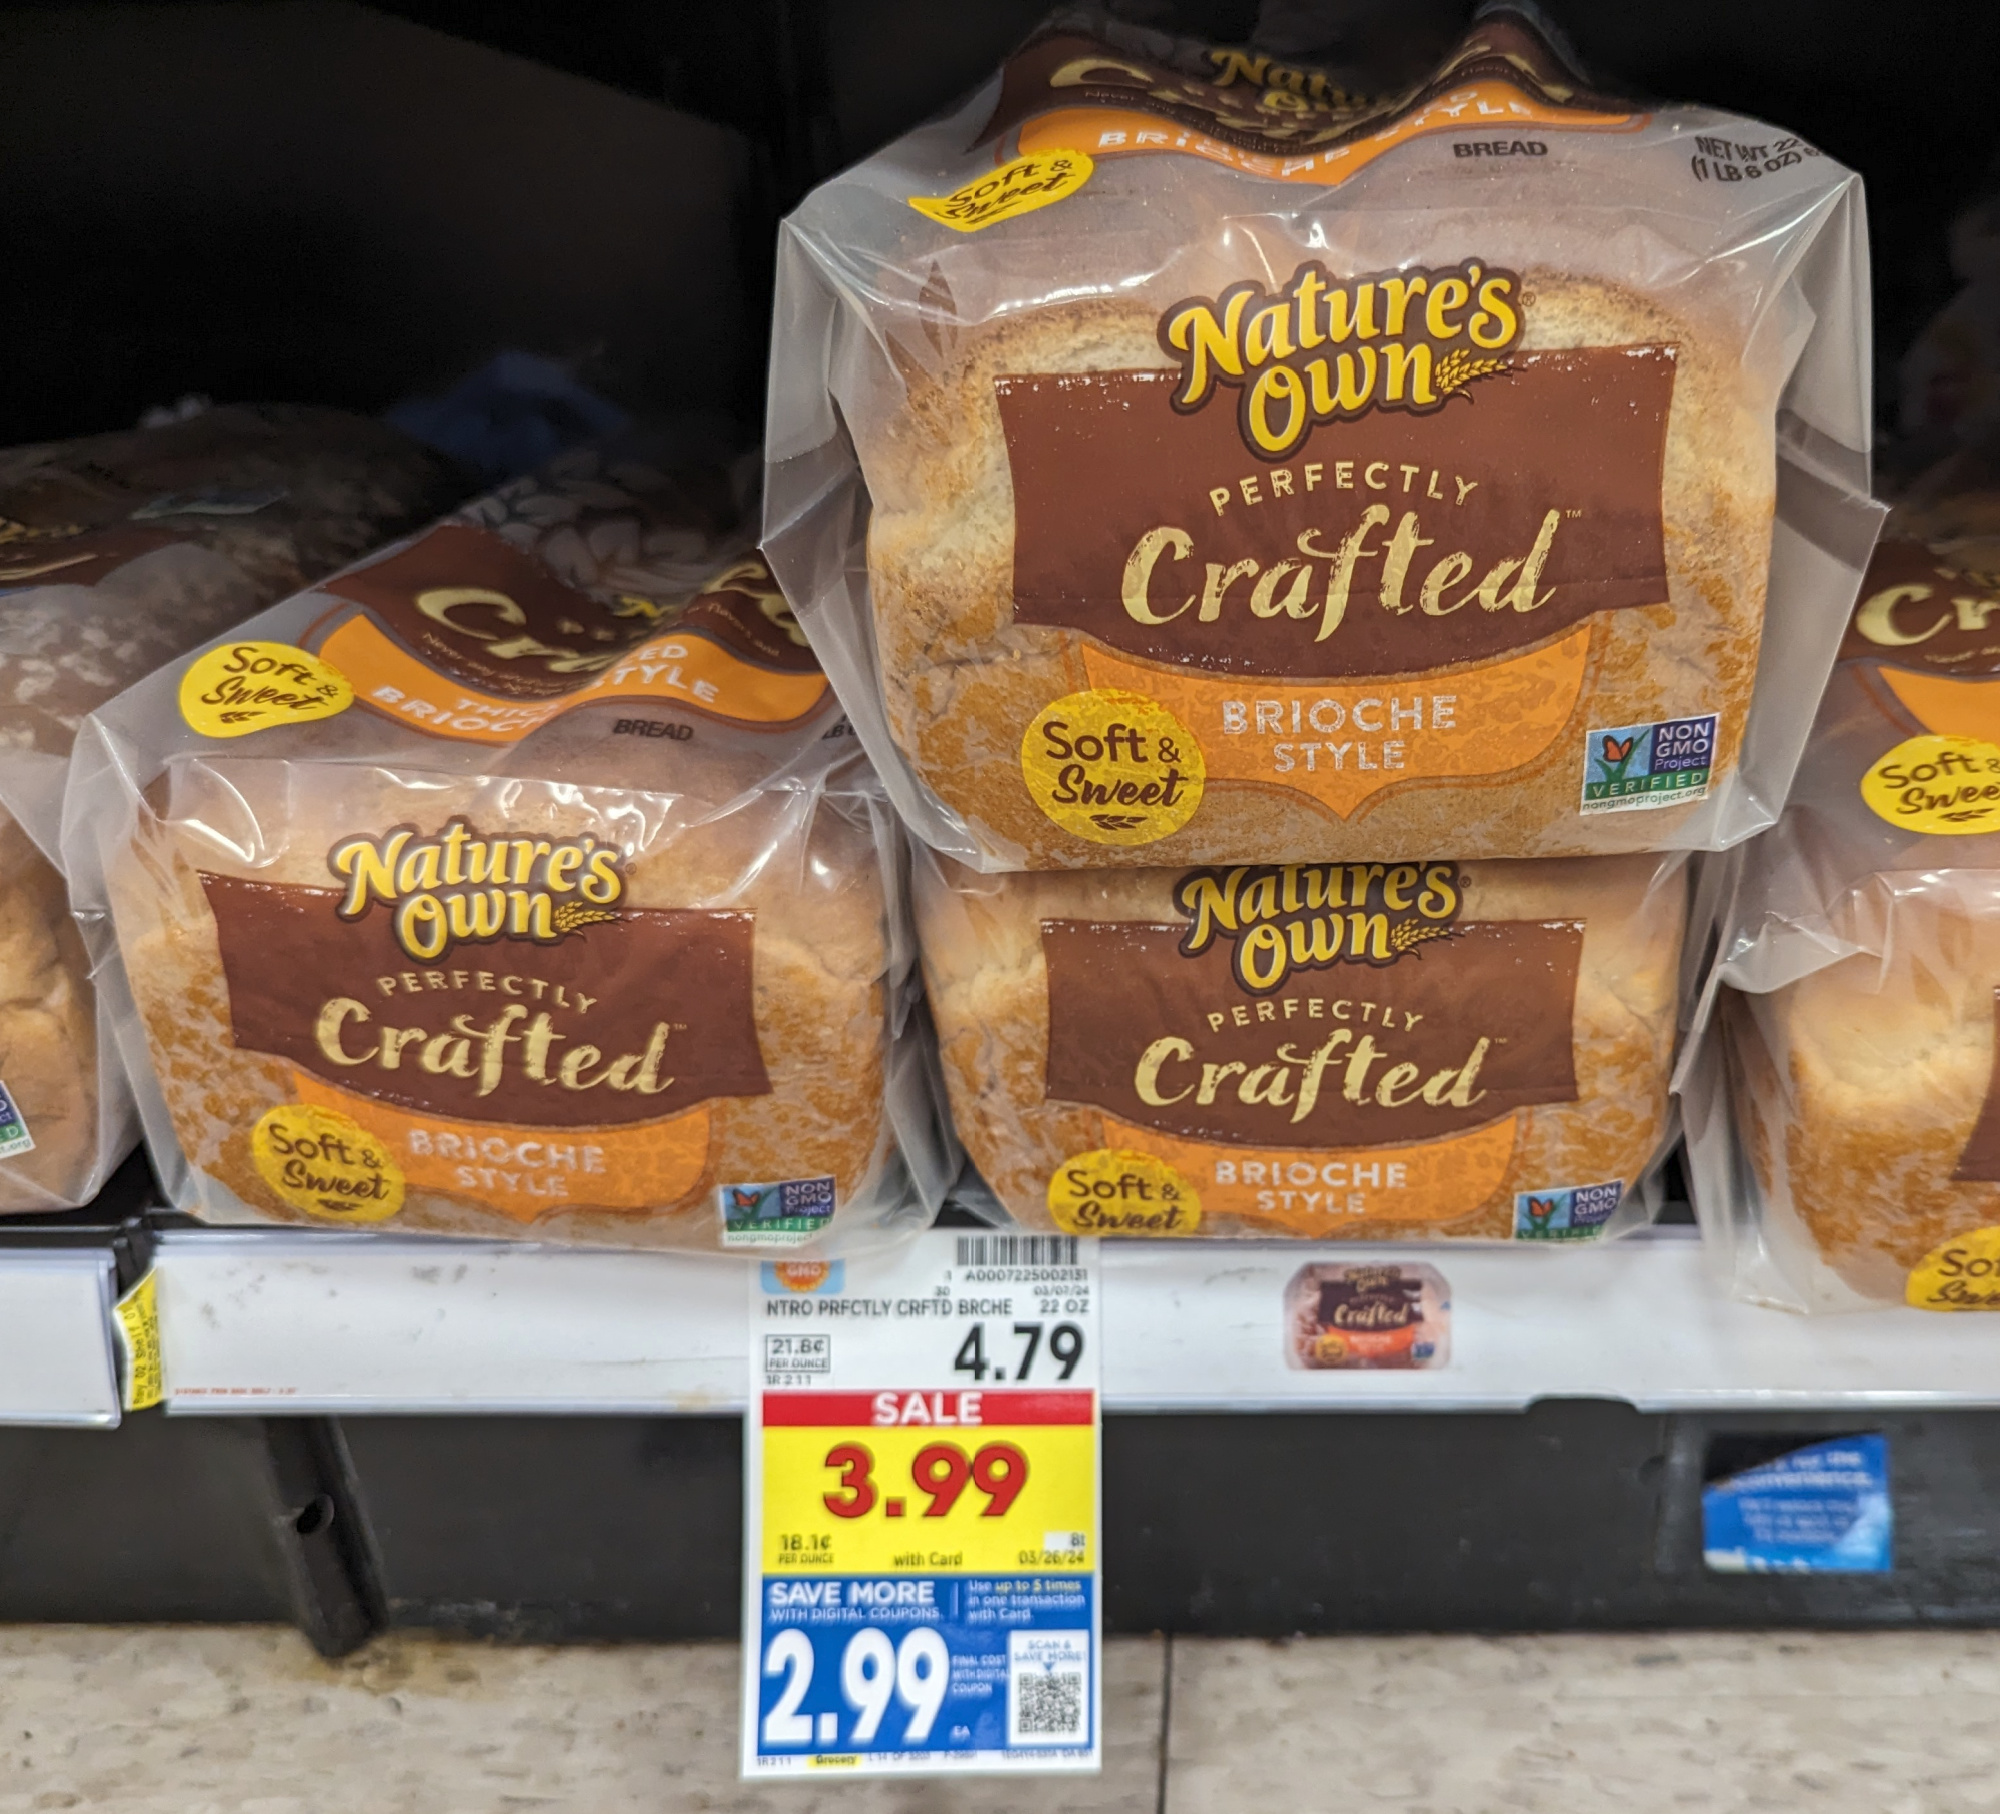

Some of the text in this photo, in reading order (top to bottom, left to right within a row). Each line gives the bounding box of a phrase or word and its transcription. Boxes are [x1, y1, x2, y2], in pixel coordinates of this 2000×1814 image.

[1453, 141, 1548, 158] BREAD
[1694, 137, 1732, 161] NET
[1713, 162, 1743, 182] LB
[1745, 165, 1763, 179] 6
[1764, 151, 1802, 173] OZ)
[935, 171, 1076, 219] Sweet
[945, 159, 1073, 208] Soft &
[1169, 264, 1518, 404] Nature's
[1247, 341, 1437, 452] Own
[1209, 460, 1479, 516] PERFECTLY
[1121, 503, 1561, 642] Crafted
[222, 646, 339, 699] Soft &
[201, 675, 329, 711] Sweet
[612, 718, 694, 742] BREAD
[1222, 694, 1458, 736] BRIOCHE
[1042, 721, 1182, 766] Soft &
[1656, 738, 1709, 758] GMO
[1658, 721, 1711, 743] NON
[1273, 739, 1406, 774] STYLE
[1654, 755, 1707, 772] Project
[1878, 751, 1981, 790] Soft
[1052, 766, 1189, 808] Sweet
[1582, 786, 1706, 811] nongmoproject.org
[1592, 772, 1702, 798] VERIFIED
[1896, 780, 2000, 815] Swee
[337, 822, 625, 917] Nature's
[400, 886, 559, 960] Own
[1180, 863, 1458, 951] Nature's
[1240, 912, 1392, 990] Own
[376, 971, 598, 1015] PERFECTLY
[1207, 998, 1424, 1034] PERFECTLY
[314, 997, 675, 1098] Crafted
[1134, 1028, 1490, 1125] Crafted
[267, 1122, 385, 1170] Soft &
[409, 1128, 607, 1175] BRIOCHE
[282, 1160, 393, 1201] Sweet
[454, 1165, 571, 1198] STYLE
[785, 1181, 831, 1196] NON
[1068, 1168, 1180, 1202] Soft &
[1215, 1160, 1408, 1189] BRIOCHE
[785, 1191, 832, 1207] GMO
[1256, 1190, 1367, 1216] STYLE
[1574, 1197, 1617, 1216] GMO
[1575, 1185, 1617, 1202] NON
[1071, 1201, 1182, 1231] Sweet
[767, 1298, 1090, 1315] NTRO PRFCTLY CRFTD BRCHE 22 OZ
[769, 1357, 828, 1369] PER OUNCE
[772, 1321, 1085, 1381] 21.8¢ 4.79
[872, 1391, 984, 1426] SALE
[822, 1440, 1031, 1519] 3.99
[778, 1550, 1086, 1567] PER OUNCE with Card 03/26/24
[780, 1533, 832, 1551] 18.1¢
[771, 1580, 936, 1606] SAVE MORE
[968, 1579, 992, 1592] Use
[995, 1580, 1013, 1594] up
[1015, 1579, 1030, 1591] to
[1045, 1578, 1081, 1592] times
[983, 1594, 1008, 1606] one
[1011, 1593, 1086, 1606] transaction
[770, 1606, 808, 1621] WITH
[811, 1606, 865, 1620] DIGITAL
[967, 1607, 996, 1622] with
[981, 1653, 1006, 1665] COST
[1013, 1651, 1044, 1662] SAVE
[1027, 1639, 1061, 1650] SCAN
[763, 1626, 950, 1744] 2.99
[952, 1682, 993, 1694] COUPON
[953, 1725, 971, 1737] EA
